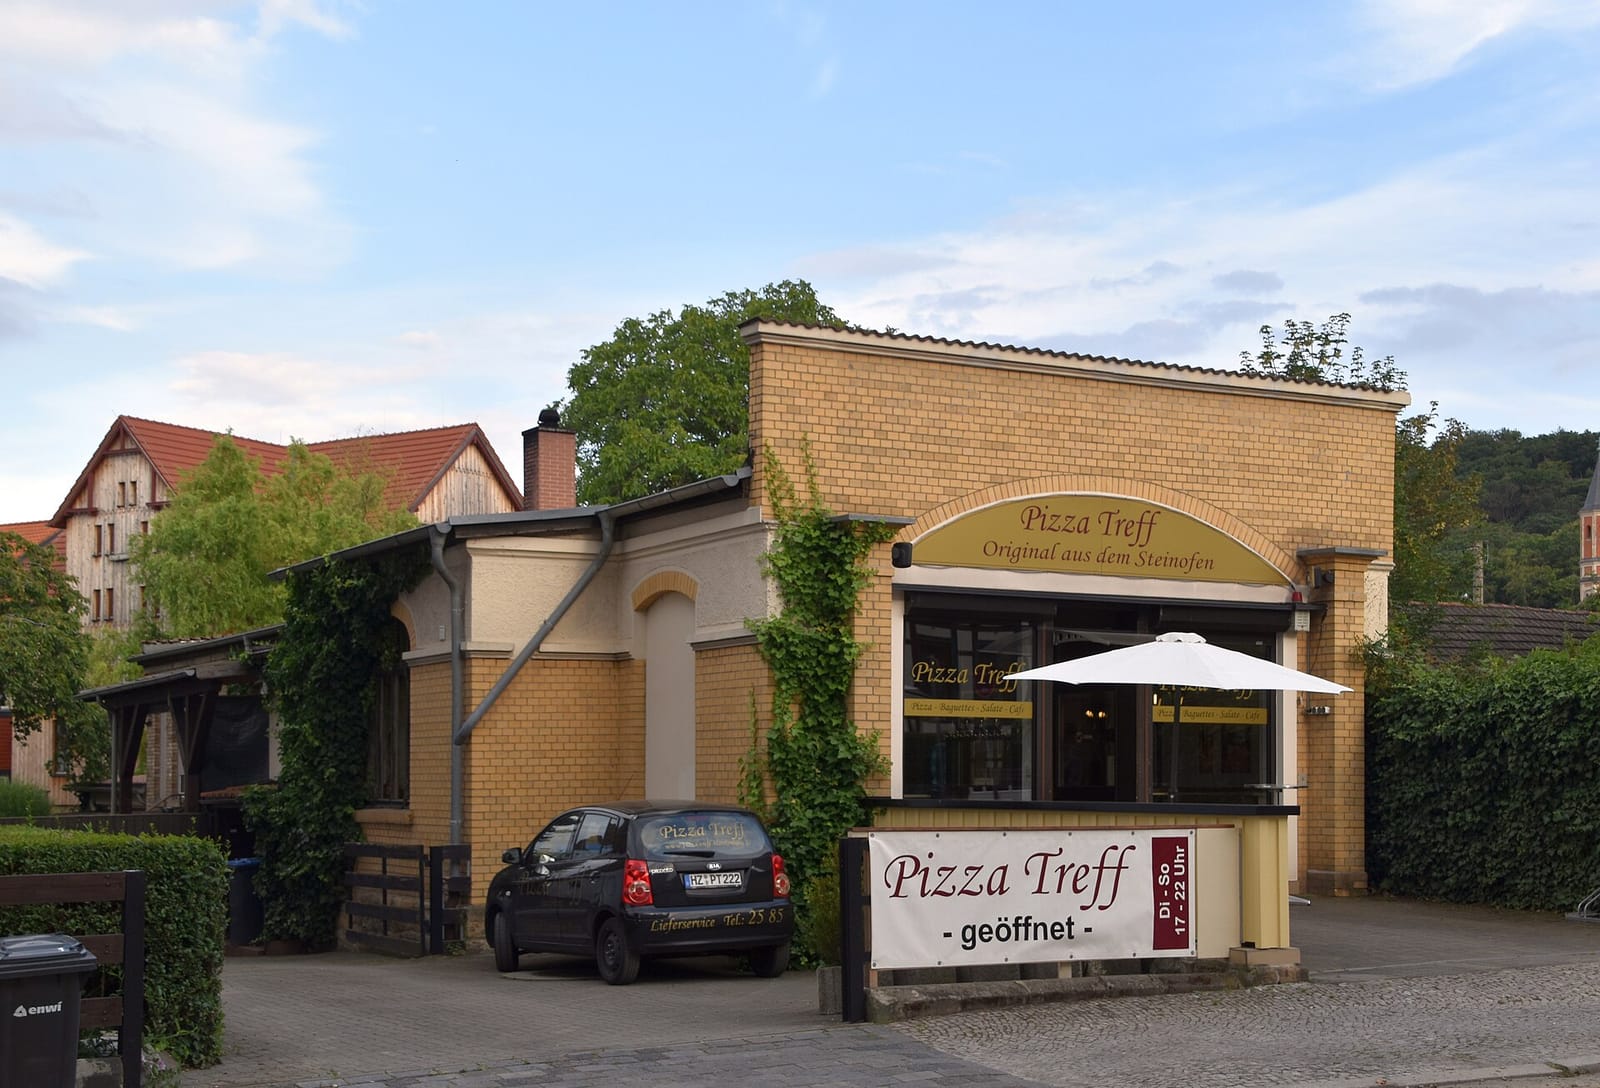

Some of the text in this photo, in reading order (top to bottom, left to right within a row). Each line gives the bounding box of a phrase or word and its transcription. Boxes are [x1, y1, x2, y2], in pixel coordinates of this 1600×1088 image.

[1020, 505, 1161, 547] Pizza Treff
[983, 540, 1215, 574] Original aus dem Steinofen
[911, 661, 1026, 693] Pizza Treff
[912, 703, 932, 711] Pizza
[940, 703, 975, 714] Baguettes
[980, 705, 1003, 713] Salate
[1184, 709, 1215, 720] Baguettes
[1221, 711, 1240, 719] Salate
[660, 823, 745, 840] Pizza Treff
[1173, 845, 1186, 876] Uhr
[690, 876, 703, 885] HZ
[884, 845, 1136, 911] Pizza Treff
[1158, 863, 1170, 885] So
[1174, 881, 1186, 901] 22
[650, 908, 784, 933] Lieferservice Tel.: 25 85
[1159, 901, 1170, 919] Di
[961, 915, 1075, 950] geöffnet
[1174, 916, 1186, 935] 17
[28, 1001, 63, 1015] enwi
